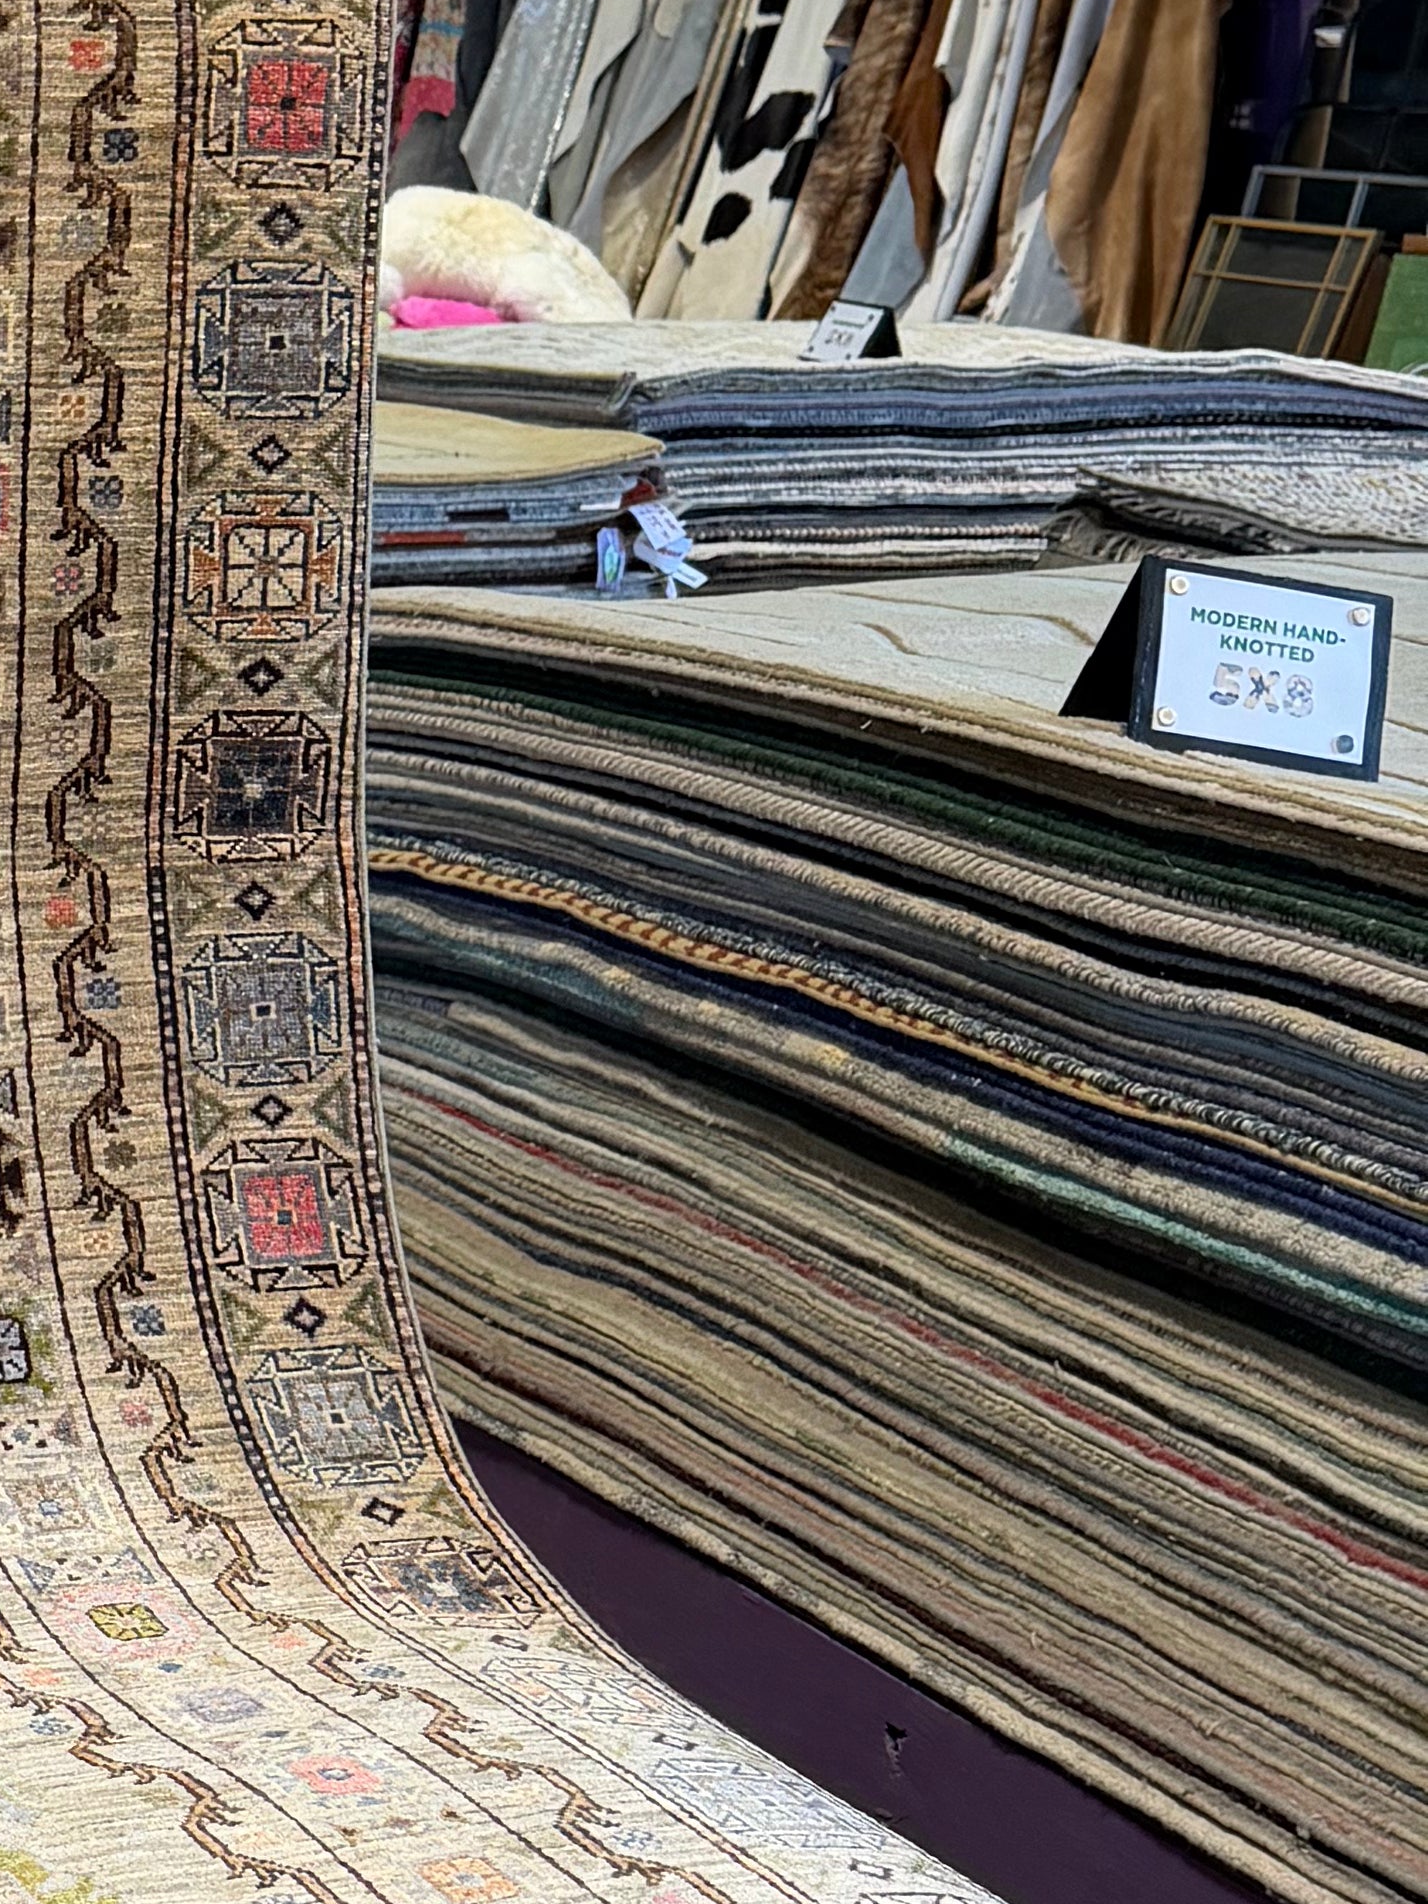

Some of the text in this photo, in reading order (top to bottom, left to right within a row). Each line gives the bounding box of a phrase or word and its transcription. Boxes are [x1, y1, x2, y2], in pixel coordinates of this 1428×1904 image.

[1190, 605, 1347, 645] MODERN HAND-
[1219, 633, 1315, 664] KNOTTED
[1208, 661, 1315, 718] 5X8
